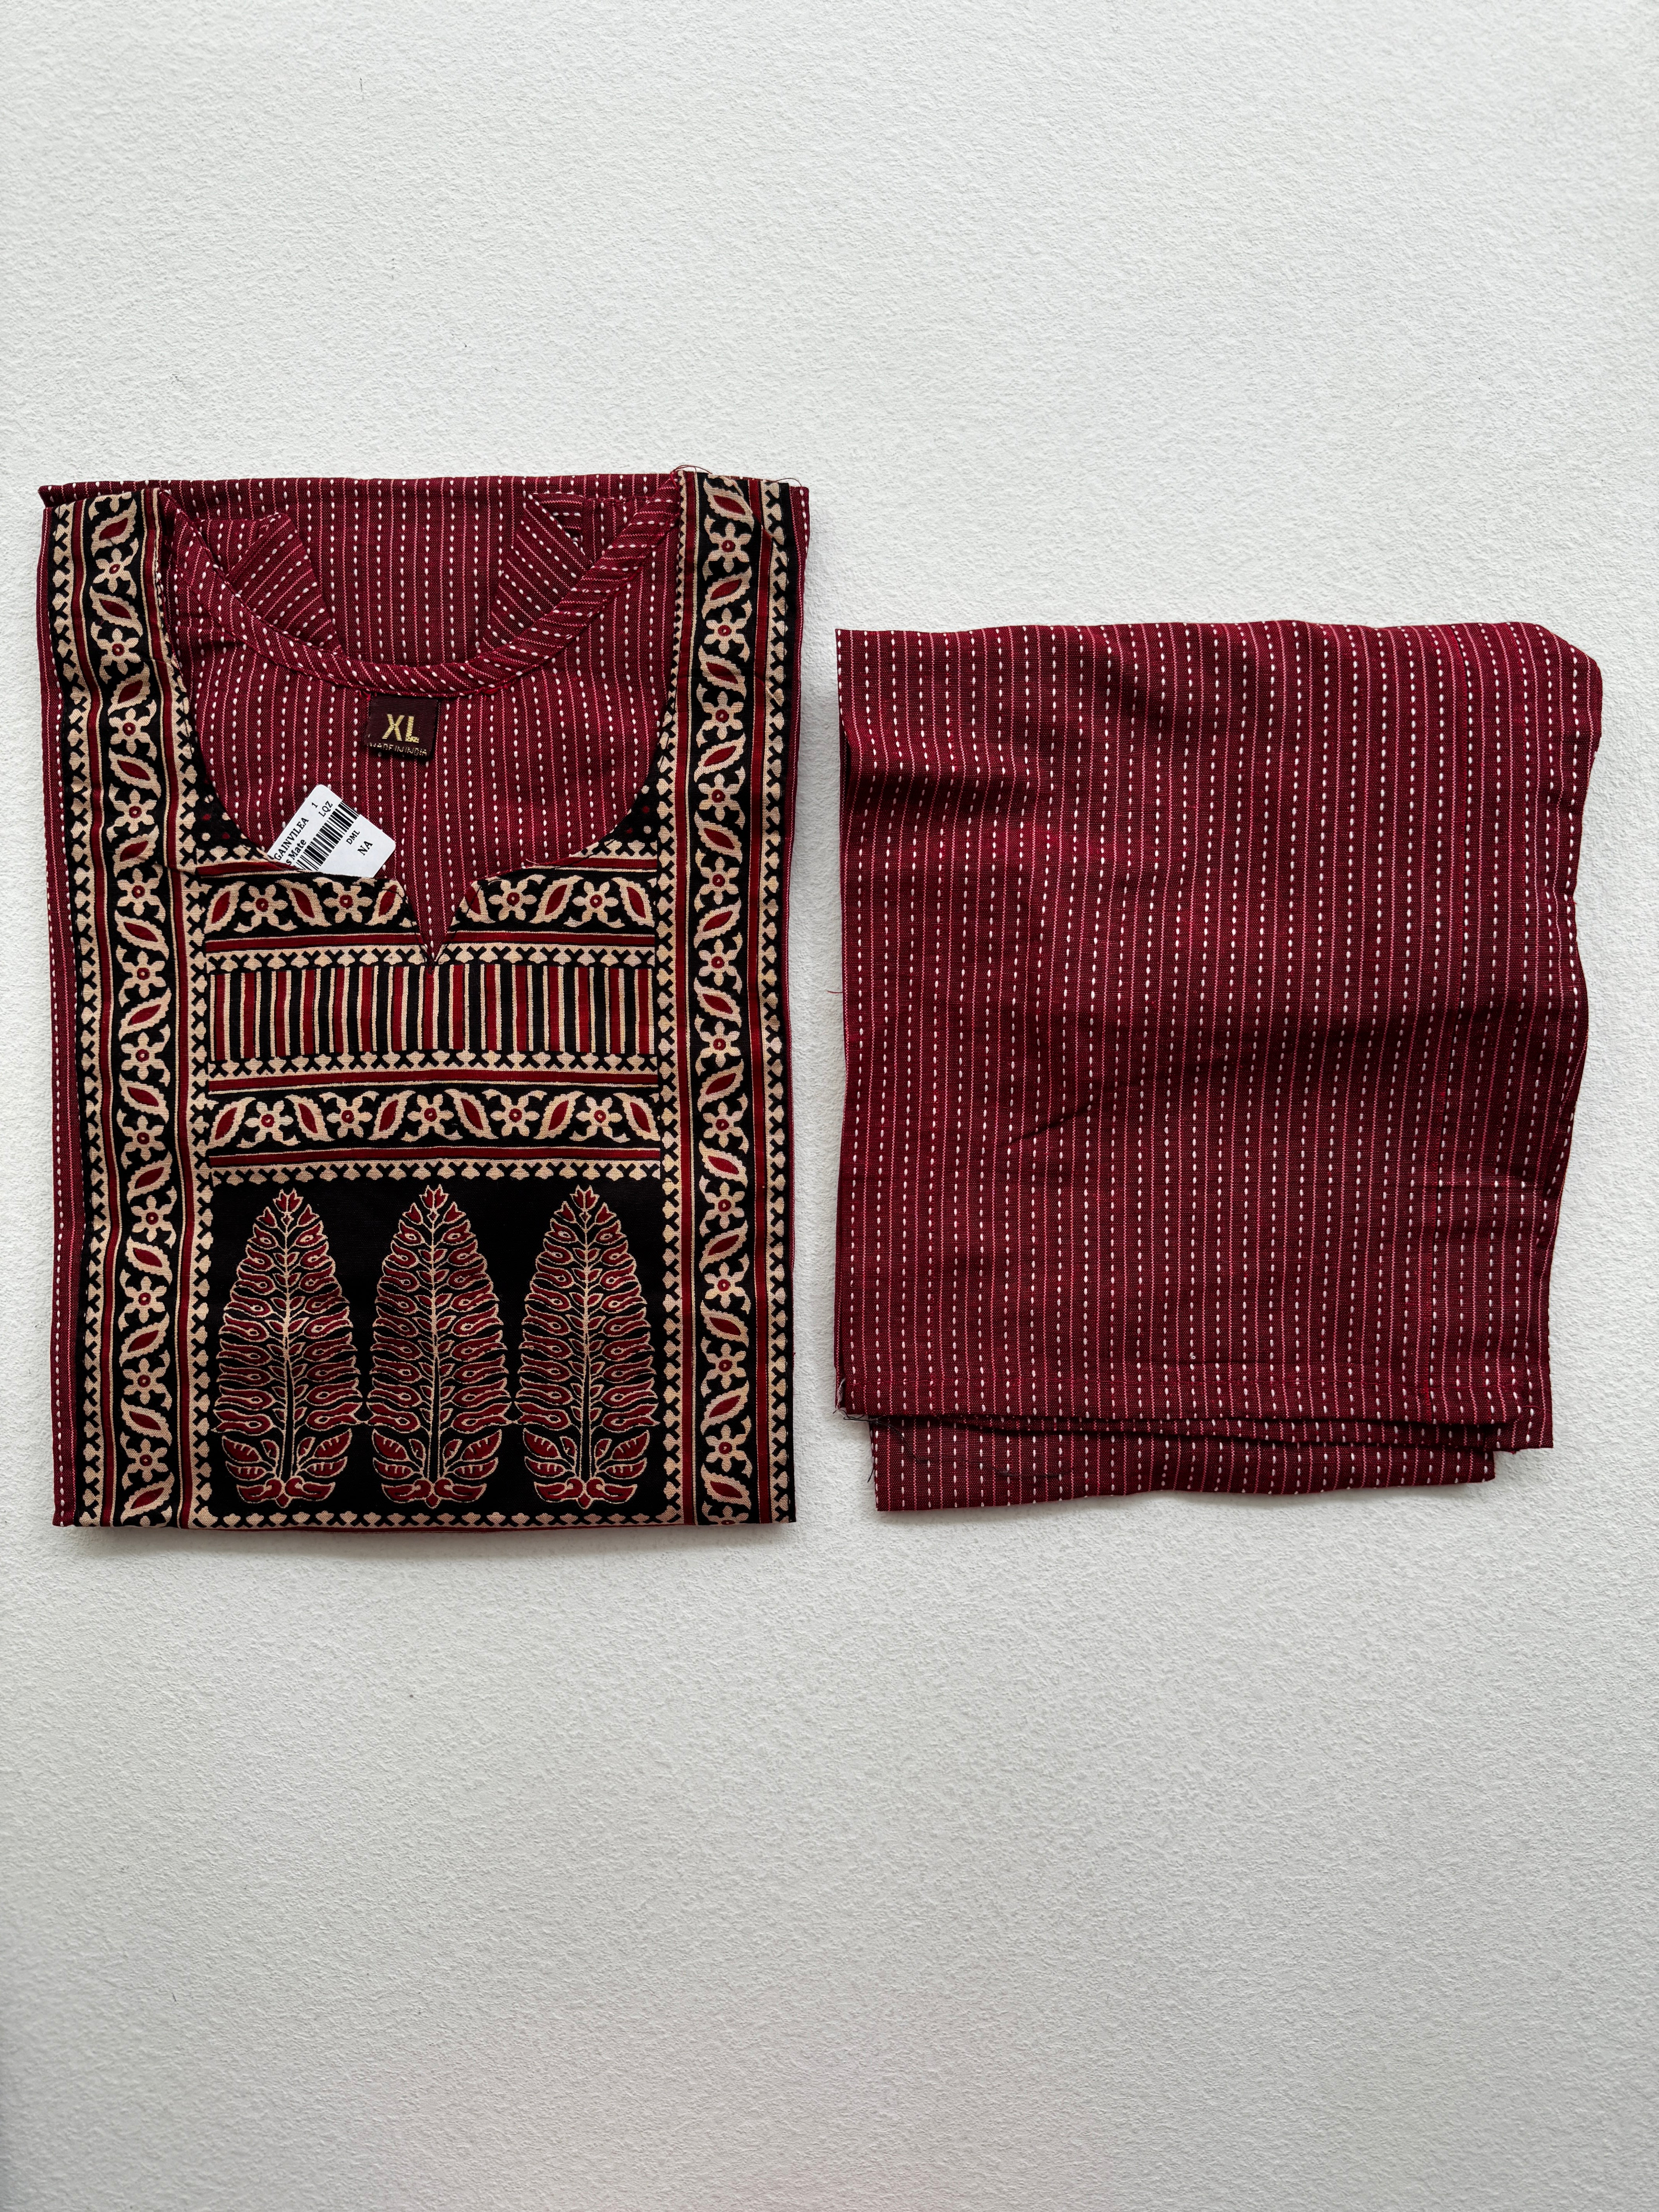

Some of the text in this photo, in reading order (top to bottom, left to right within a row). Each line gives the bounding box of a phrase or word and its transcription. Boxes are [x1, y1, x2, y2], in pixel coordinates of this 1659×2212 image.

[382, 714, 419, 743] XL
[318, 800, 333, 817] LQZ
[346, 830, 360, 845] DML
[288, 839, 307, 860] Mate
[357, 841, 373, 856] NA
